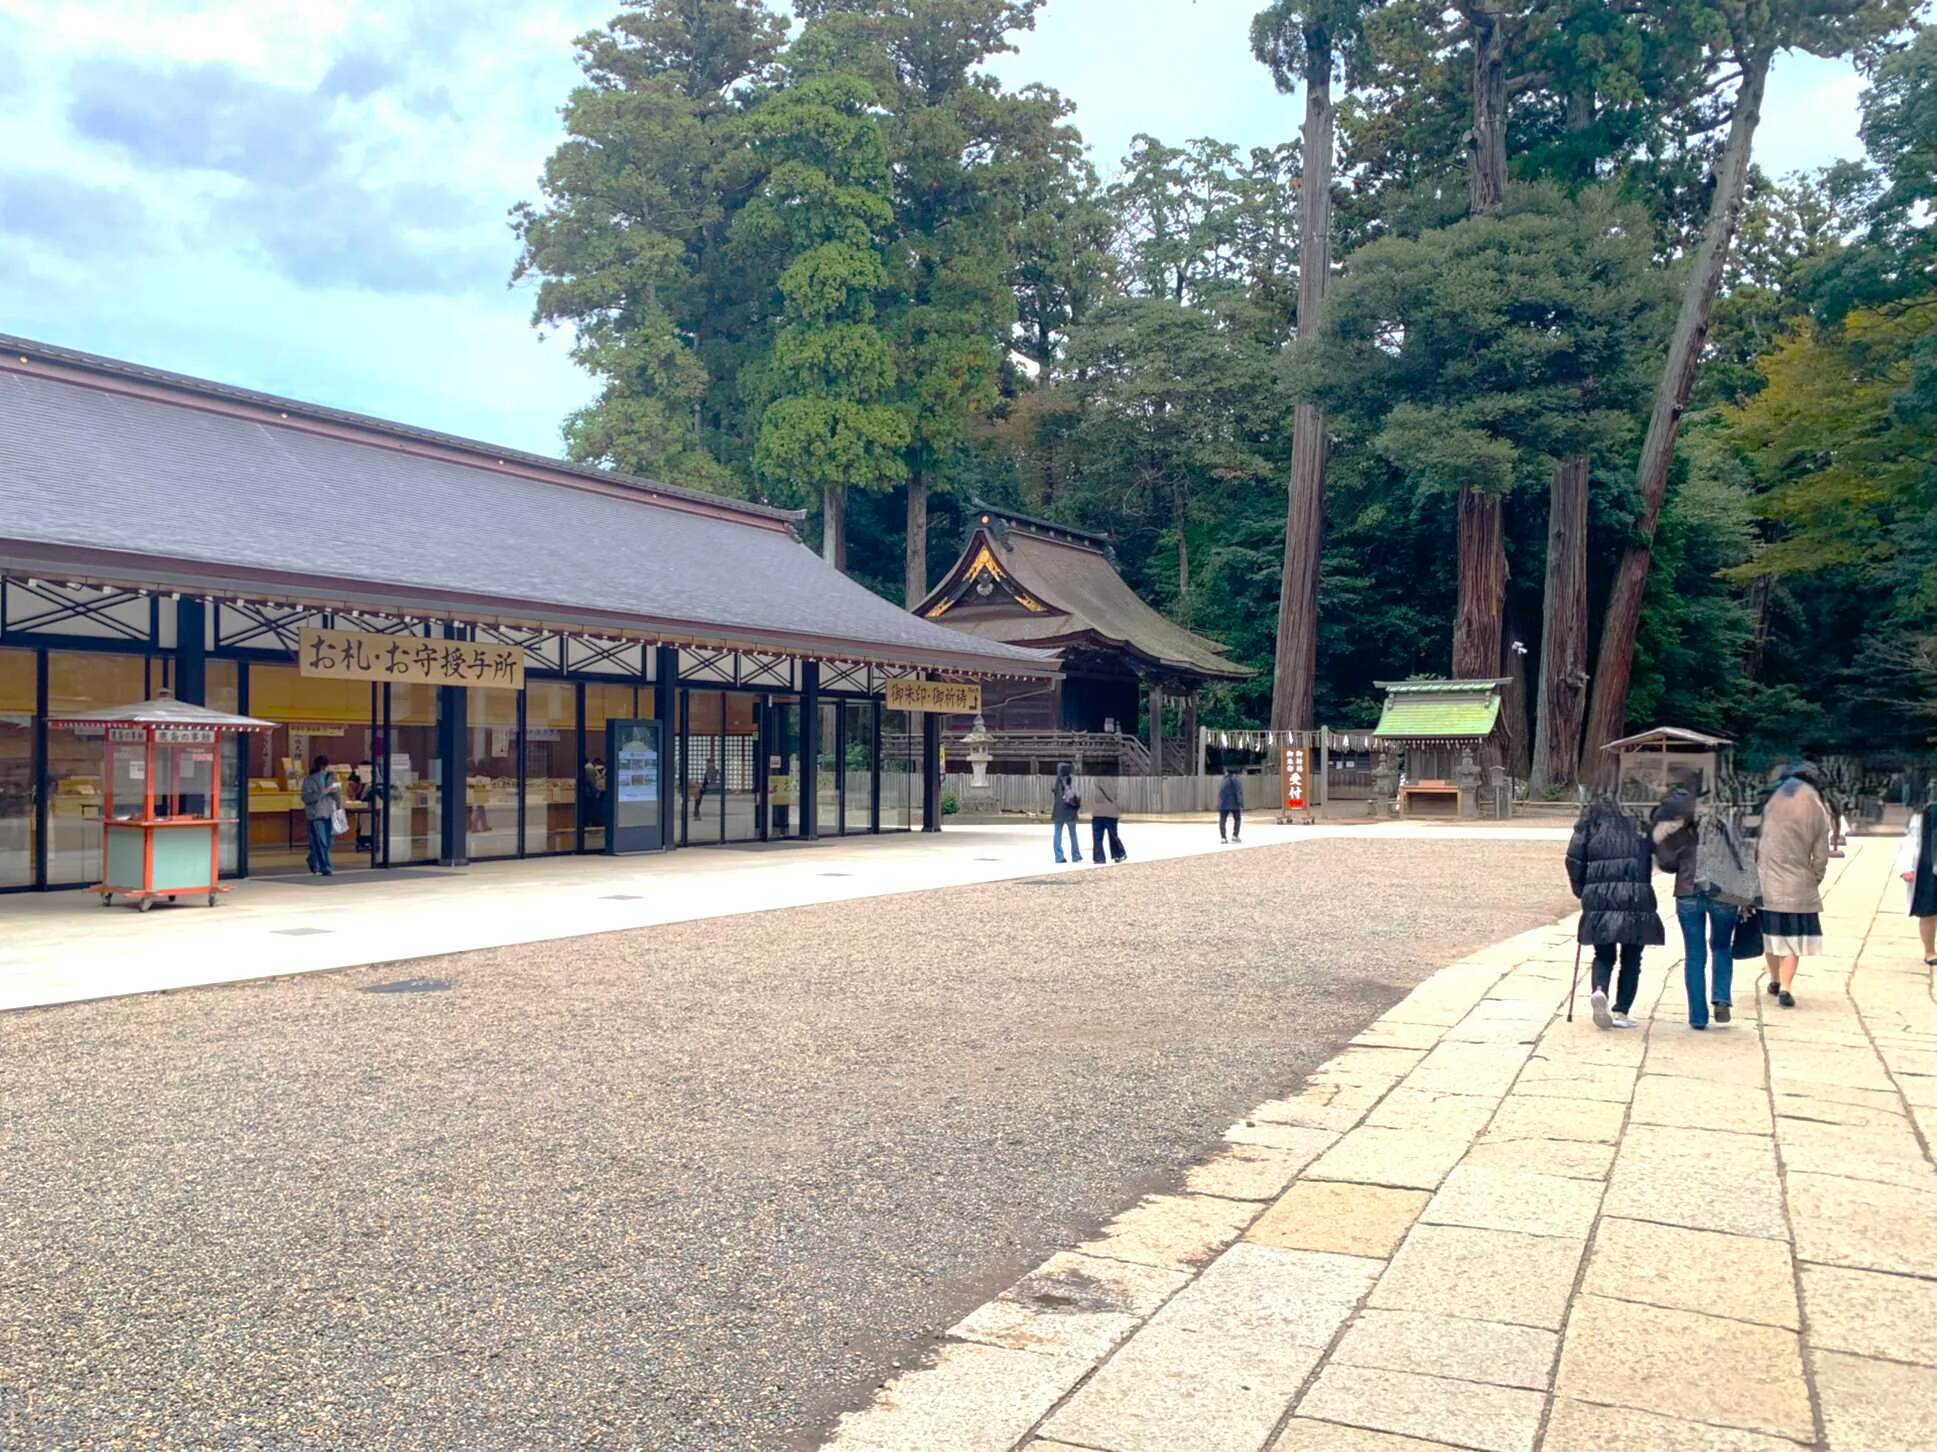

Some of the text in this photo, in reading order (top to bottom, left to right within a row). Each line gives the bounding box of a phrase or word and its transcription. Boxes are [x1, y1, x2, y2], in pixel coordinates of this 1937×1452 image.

[309, 635, 517, 684] お札・お守授与所
[1289, 772, 1302, 799] 受付
